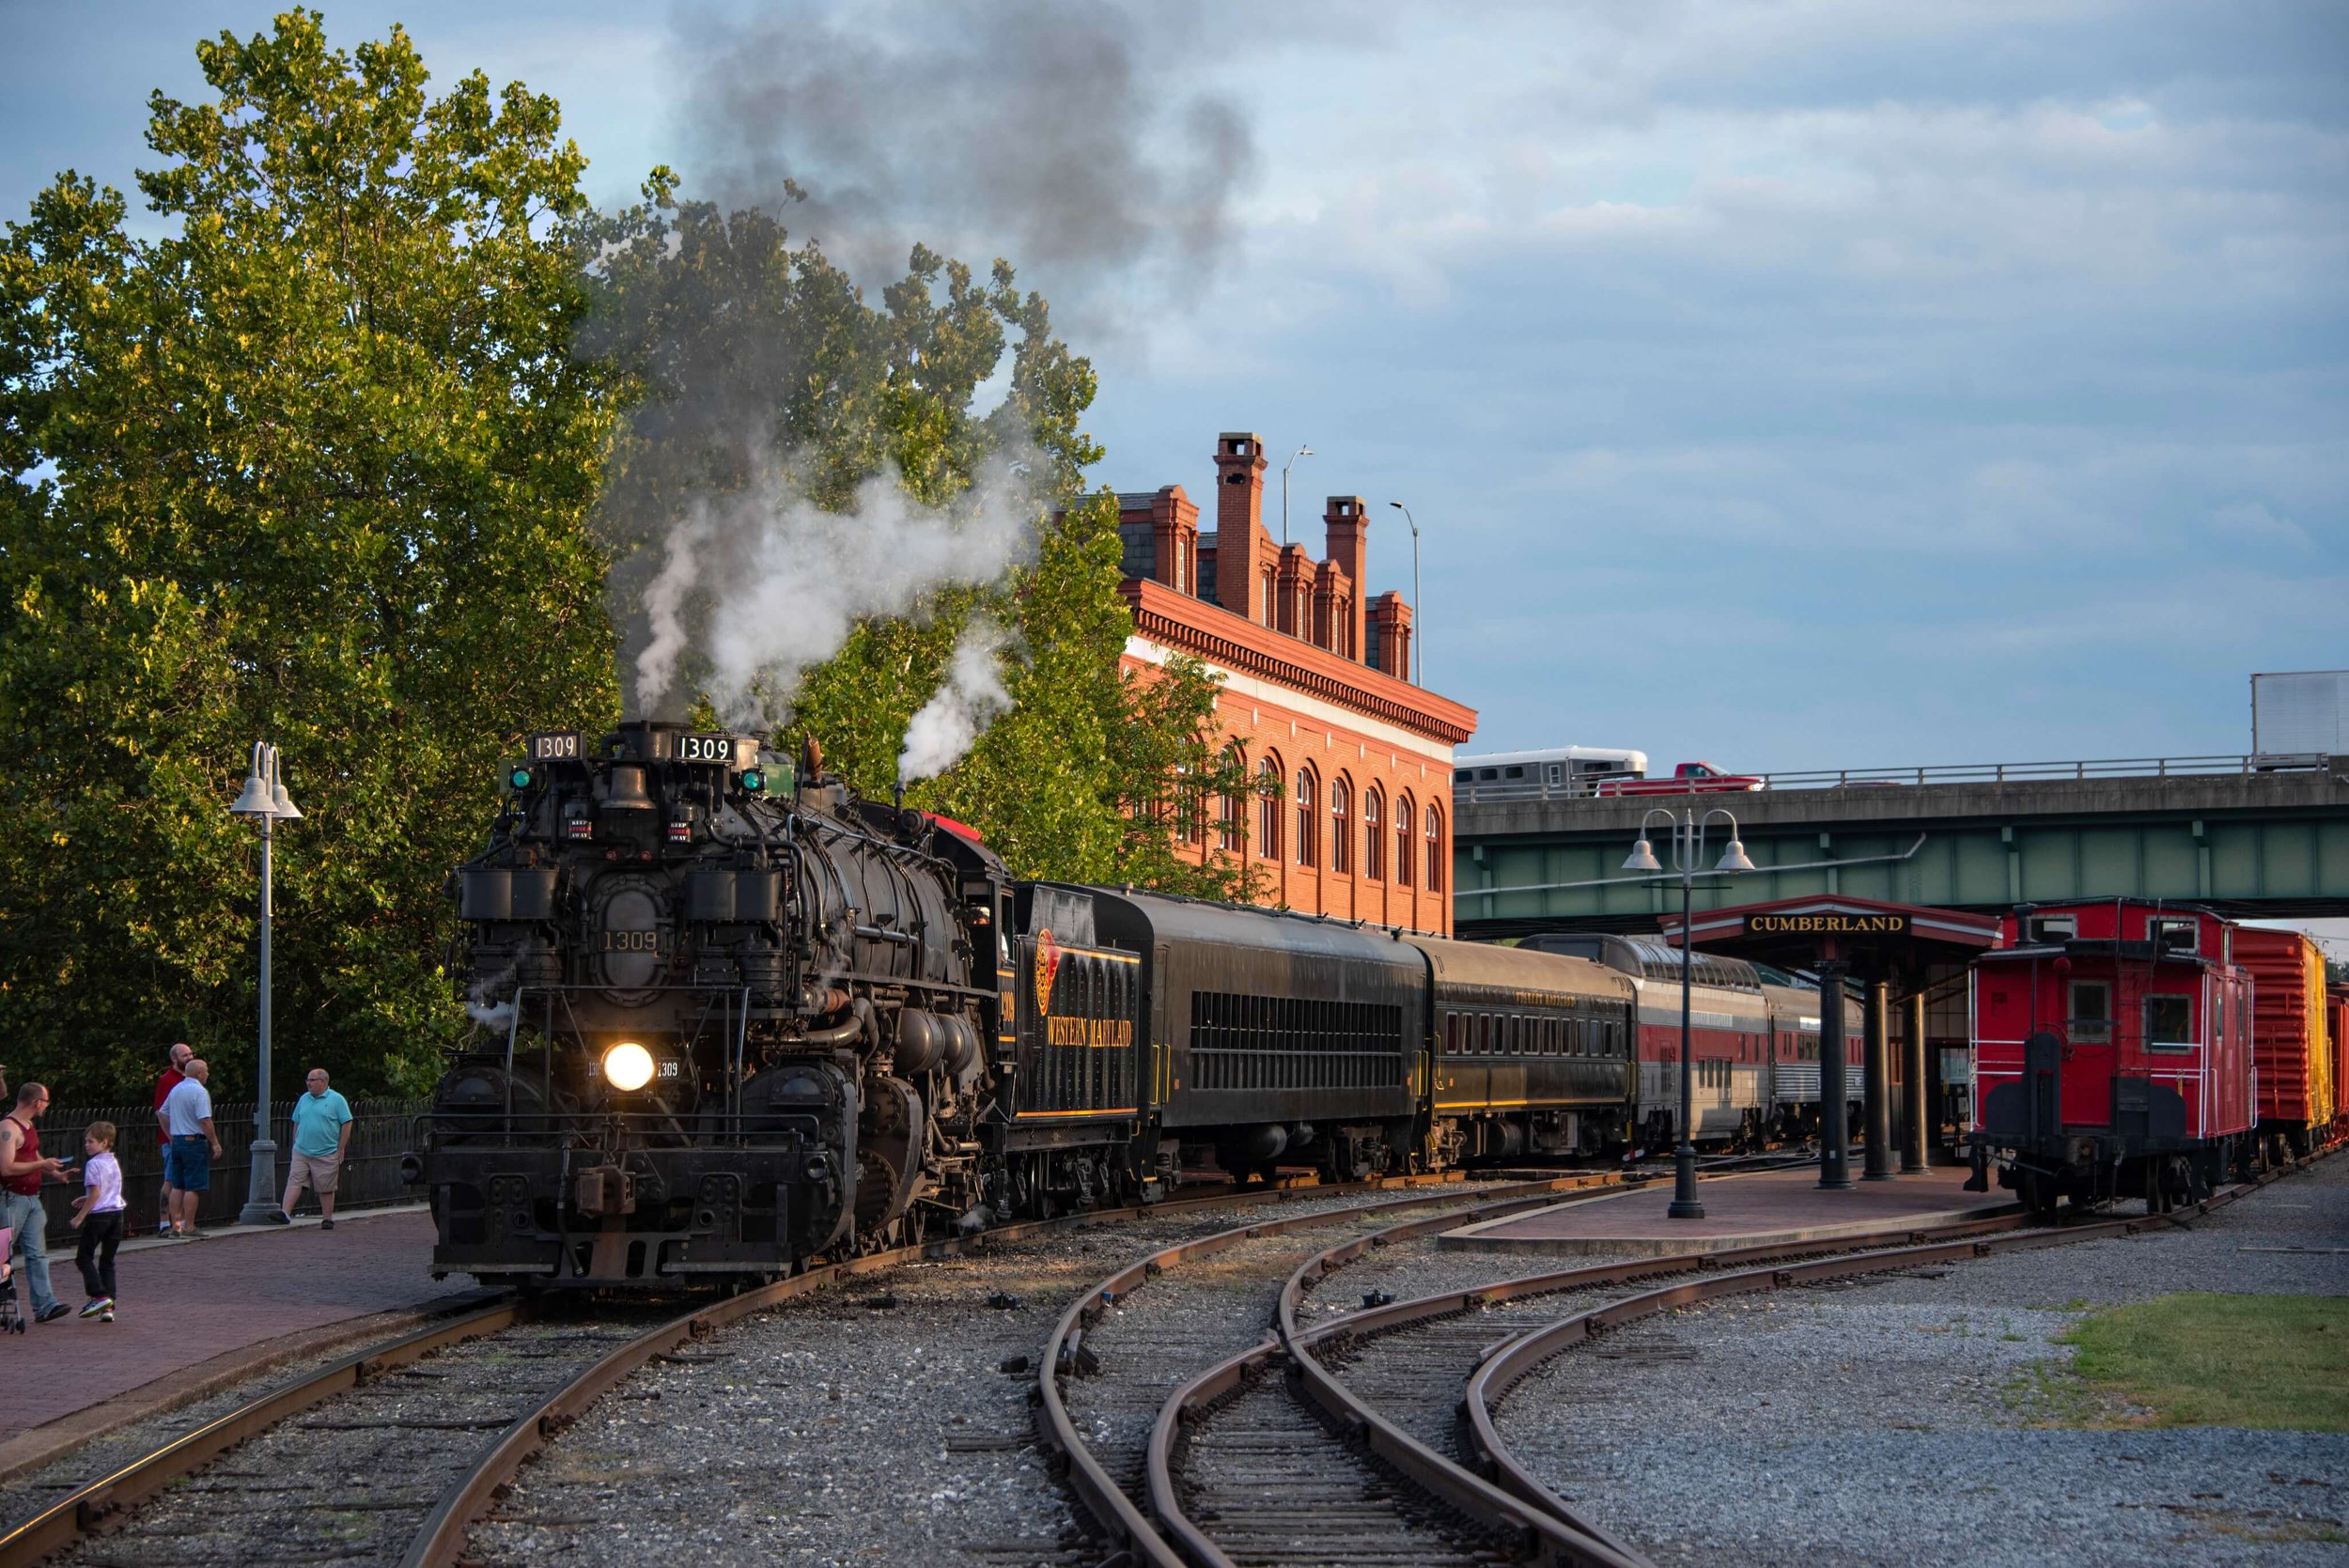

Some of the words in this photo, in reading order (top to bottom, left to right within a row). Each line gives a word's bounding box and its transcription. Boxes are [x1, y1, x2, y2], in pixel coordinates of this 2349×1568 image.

[537, 737, 574, 758] 1309
[681, 737, 729, 760] 1309
[1750, 916, 1904, 931] CUMBERLAND
[604, 931, 657, 950] 1309
[1048, 1016, 1087, 1047] WESTERN
[1089, 1018, 1131, 1048] MARYLAND
[658, 1062, 677, 1078] 1309
